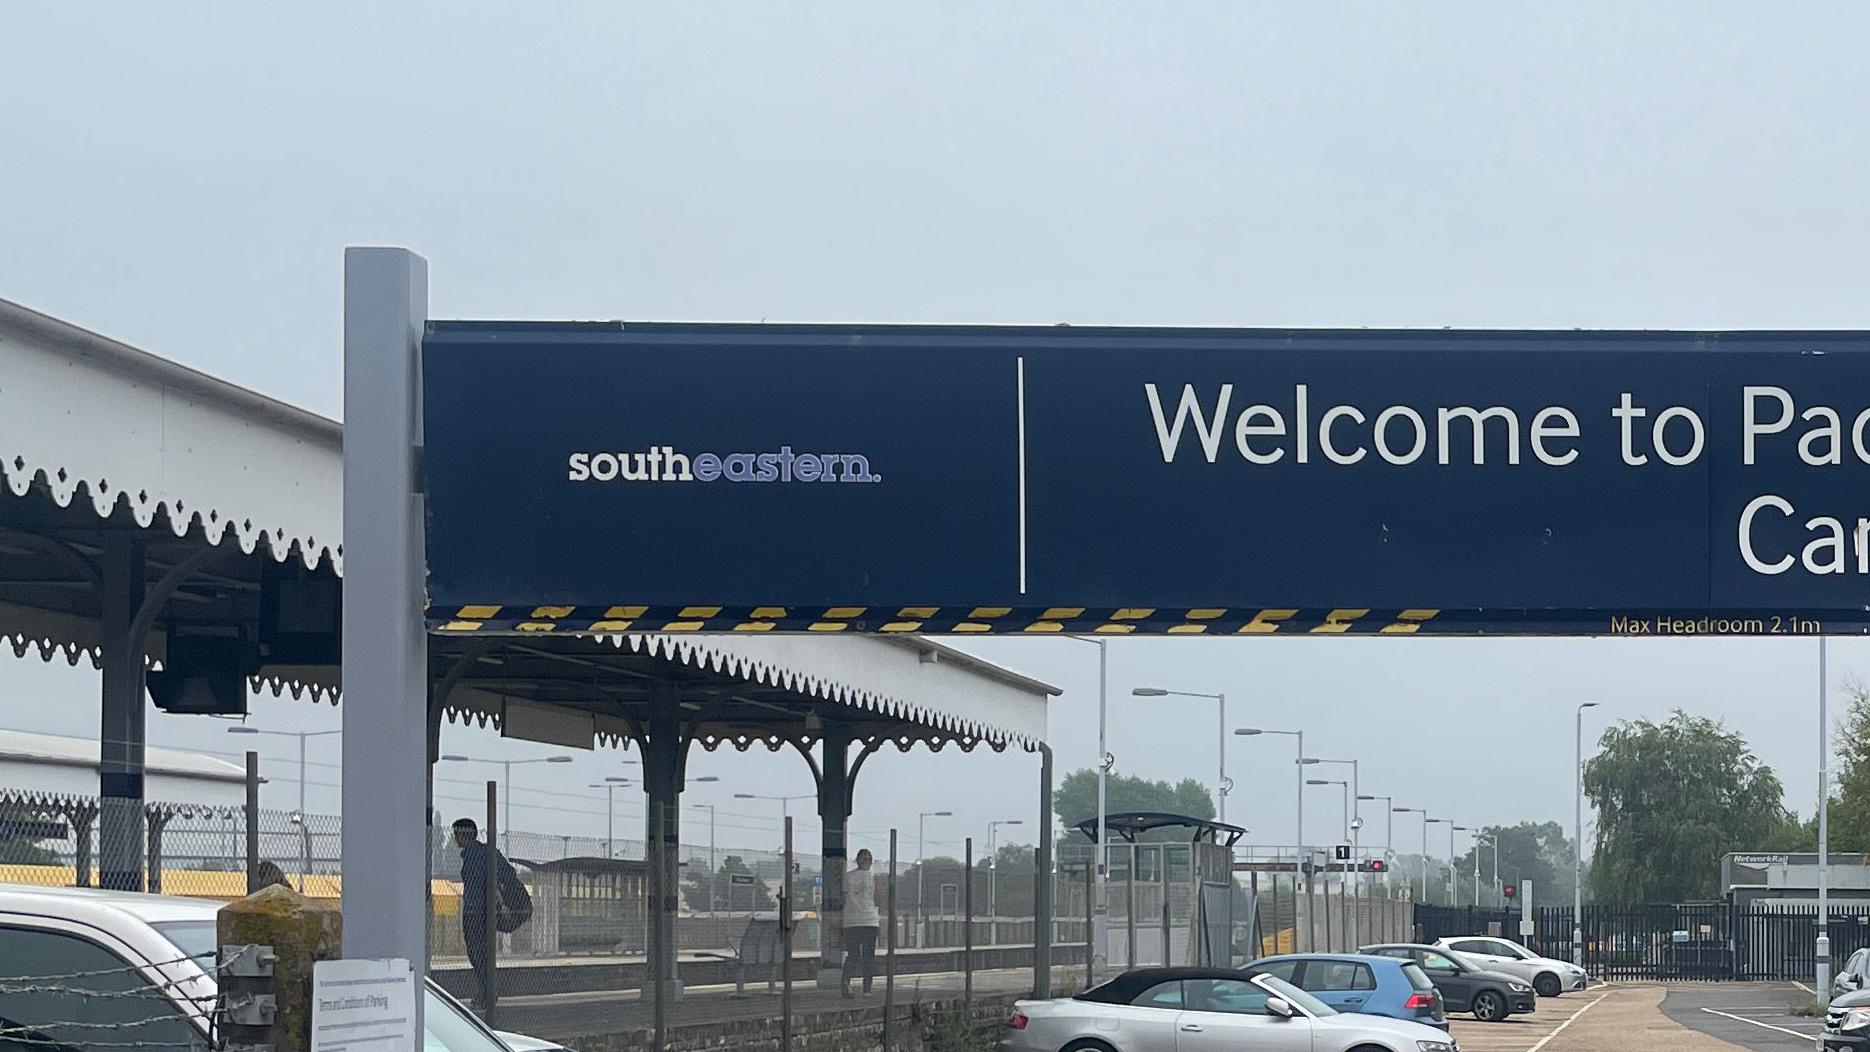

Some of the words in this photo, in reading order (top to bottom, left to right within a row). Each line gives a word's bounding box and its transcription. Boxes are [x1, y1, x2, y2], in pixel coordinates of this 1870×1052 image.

[1145, 383, 1581, 466] Welcome
[1612, 392, 1705, 466] to
[568, 445, 882, 483] southeastern.
[1611, 616, 1651, 634] Max
[1656, 616, 1763, 634] Headroom
[1770, 616, 1821, 634] 2.1m
[1338, 846, 1346, 859] 1
